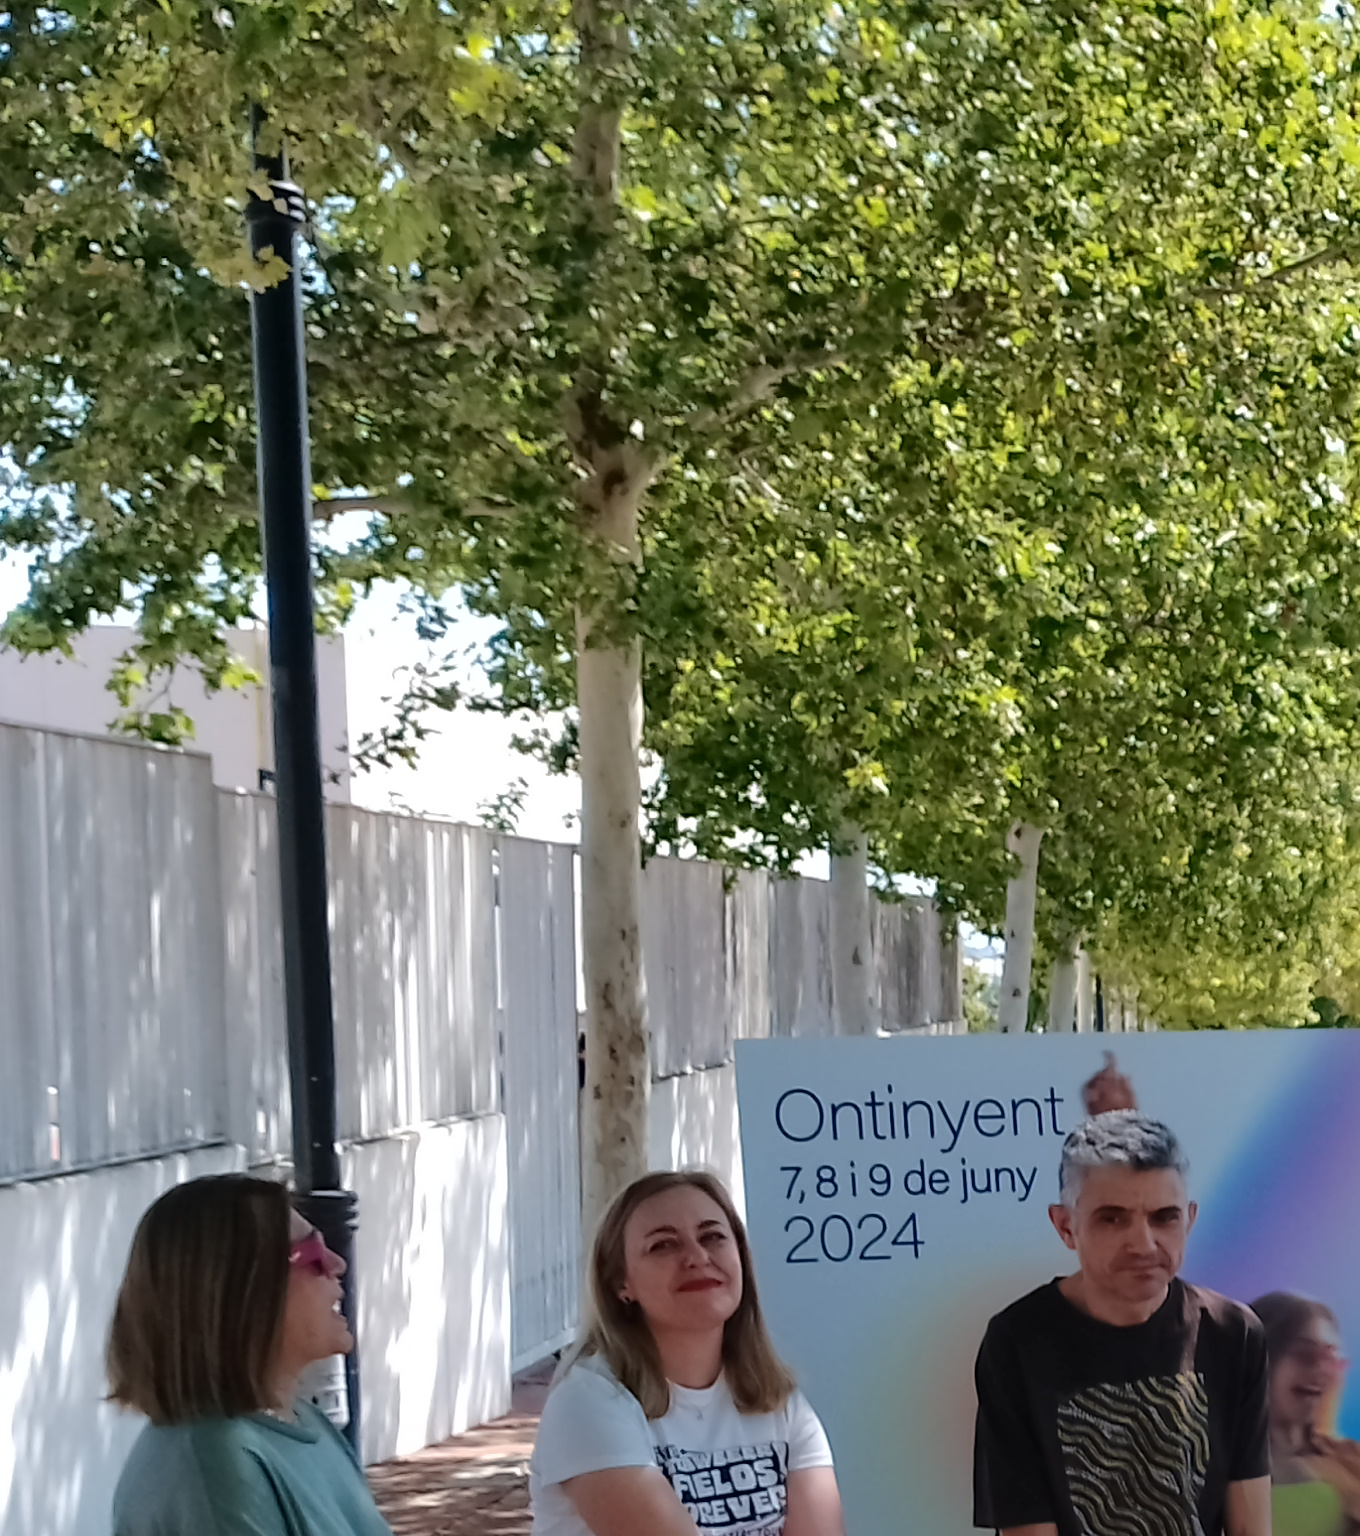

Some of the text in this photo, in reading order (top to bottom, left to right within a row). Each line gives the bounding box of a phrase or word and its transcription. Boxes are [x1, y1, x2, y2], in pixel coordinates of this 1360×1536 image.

[775, 1084, 1066, 1153] Ontinyent
[904, 1159, 950, 1196] de
[961, 1157, 1038, 1204] juny
[784, 1212, 925, 1263] 2024
